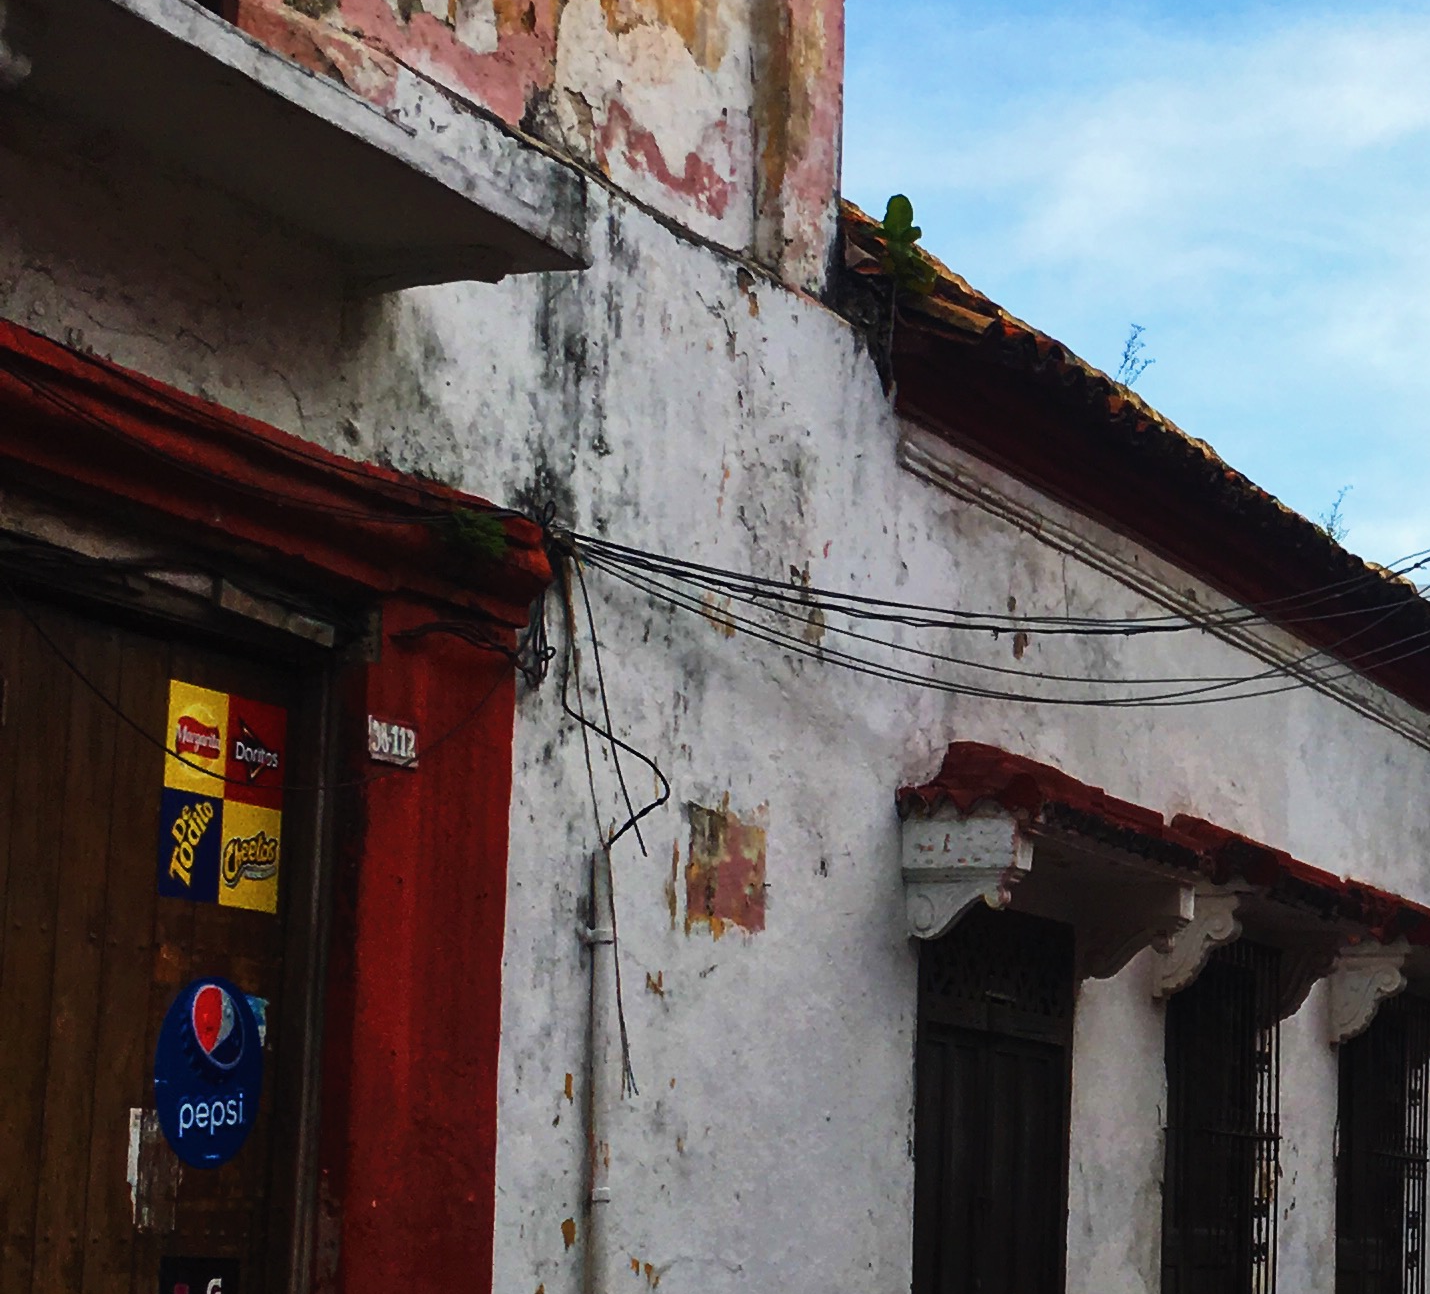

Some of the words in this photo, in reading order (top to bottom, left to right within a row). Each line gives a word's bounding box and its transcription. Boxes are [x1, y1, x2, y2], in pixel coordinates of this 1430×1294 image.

[235, 741, 279, 768] Doritos
[223, 831, 278, 883] Cheetos
[178, 1093, 244, 1138] pepsi
